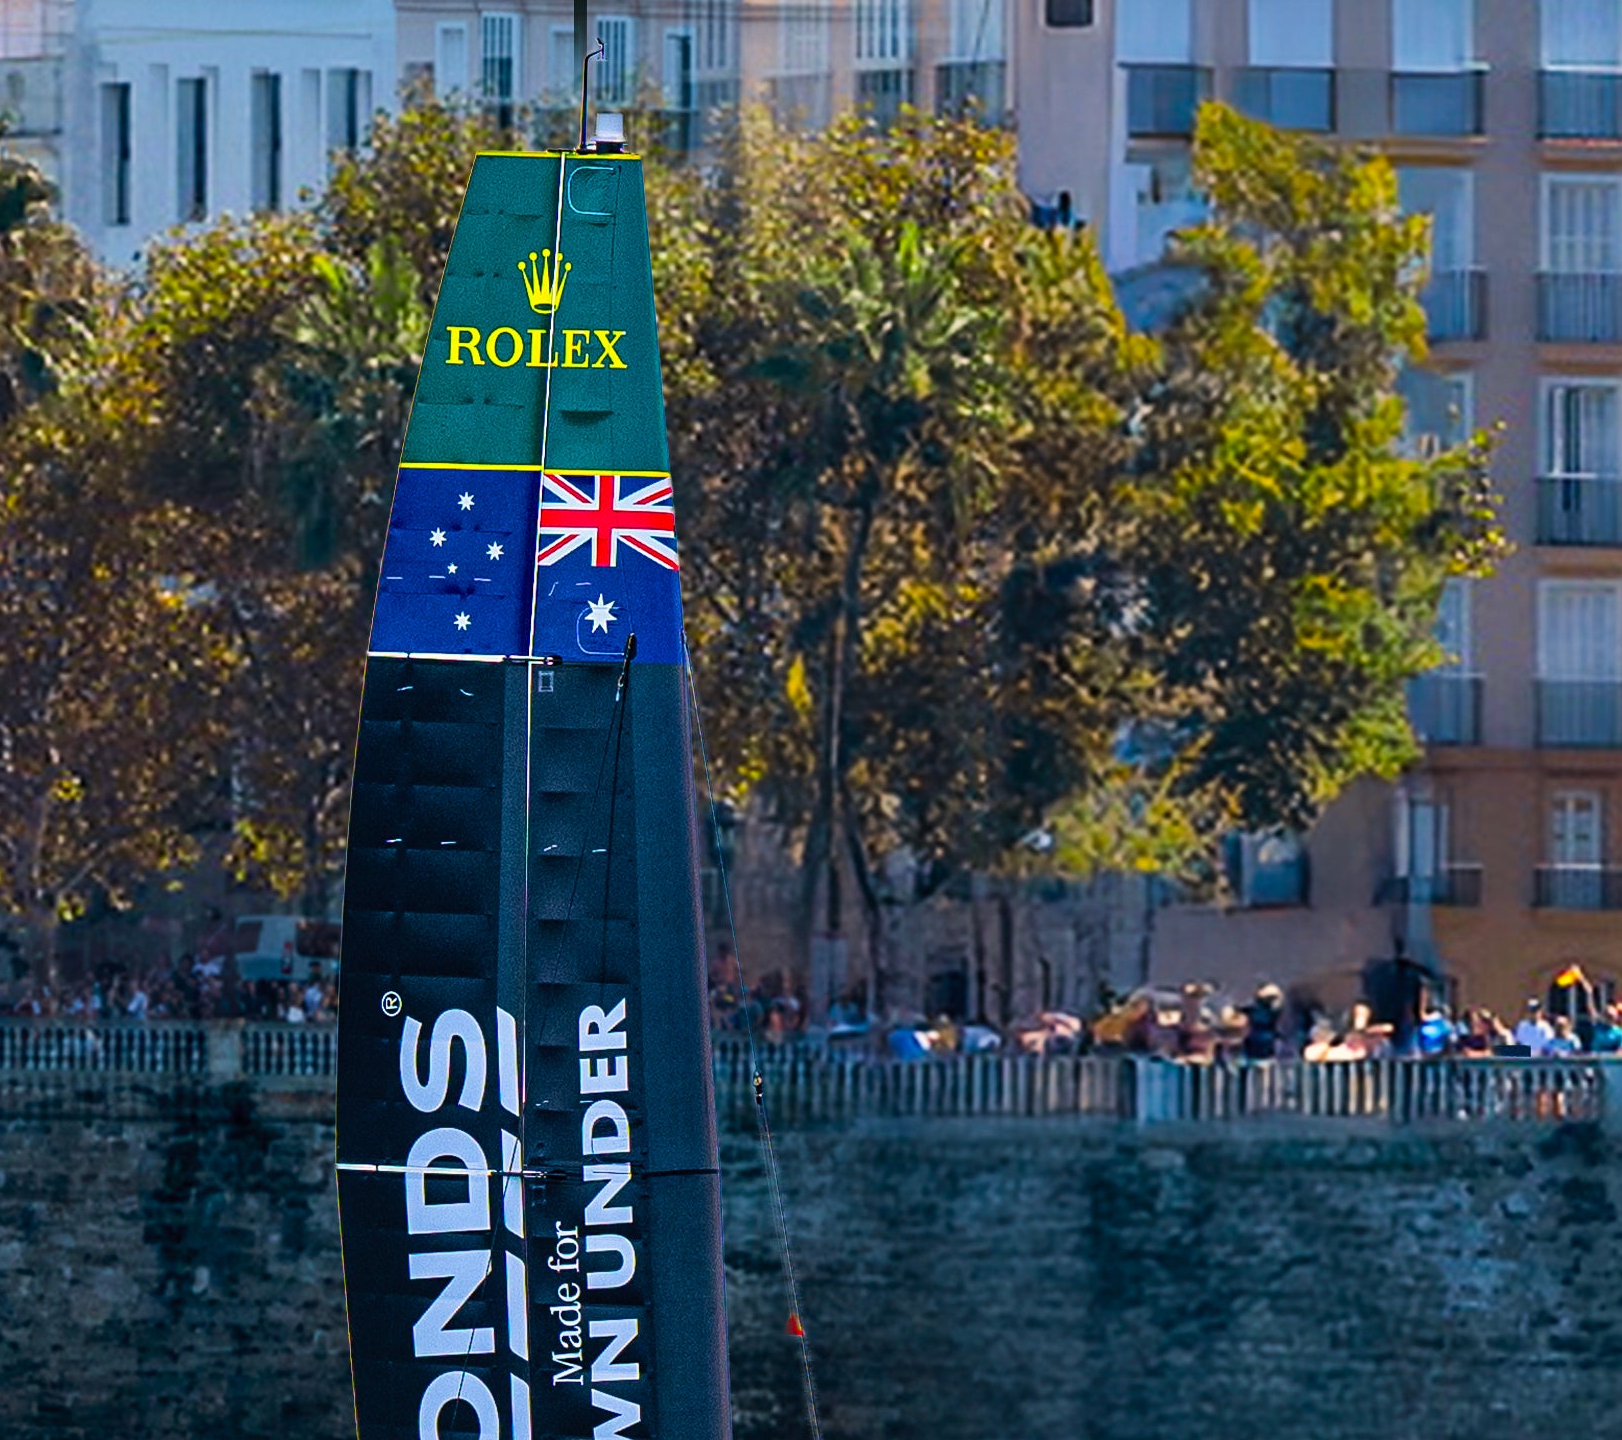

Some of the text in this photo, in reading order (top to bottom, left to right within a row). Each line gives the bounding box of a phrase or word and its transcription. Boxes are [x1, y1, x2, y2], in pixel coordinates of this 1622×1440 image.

[445, 326, 628, 369] ROLEX
[578, 999, 637, 1291] UNDER
[547, 1221, 584, 1387] Made for
